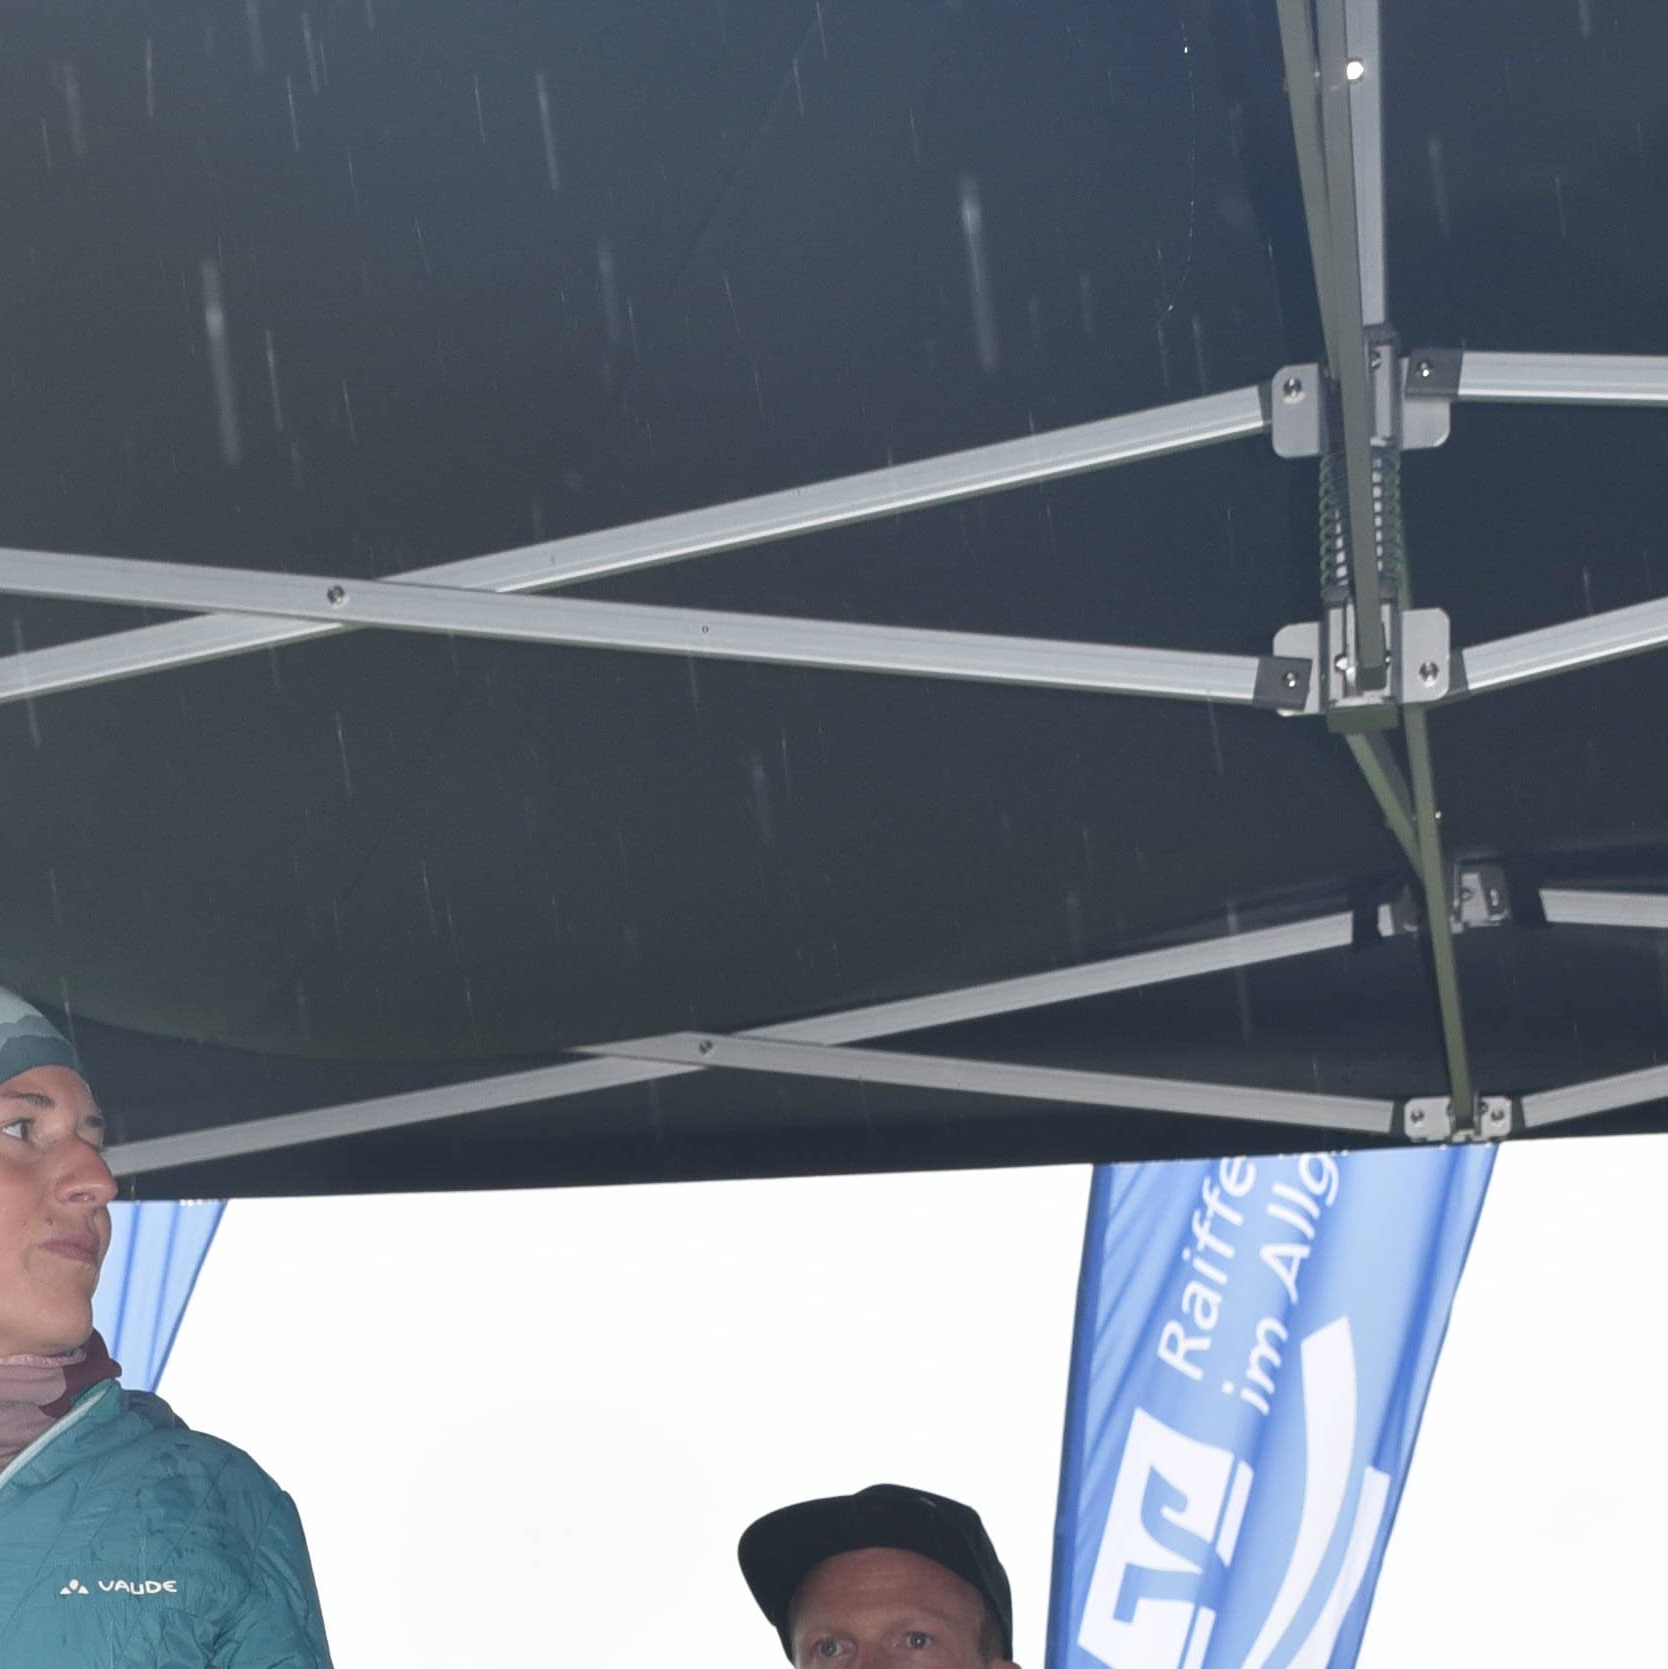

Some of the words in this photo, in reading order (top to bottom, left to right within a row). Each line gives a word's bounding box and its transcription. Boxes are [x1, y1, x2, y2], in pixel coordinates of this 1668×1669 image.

[1222, 1315, 1288, 1415] im
[1258, 1152, 1340, 1303] Allg
[97, 1579, 177, 1595] VAUDE
